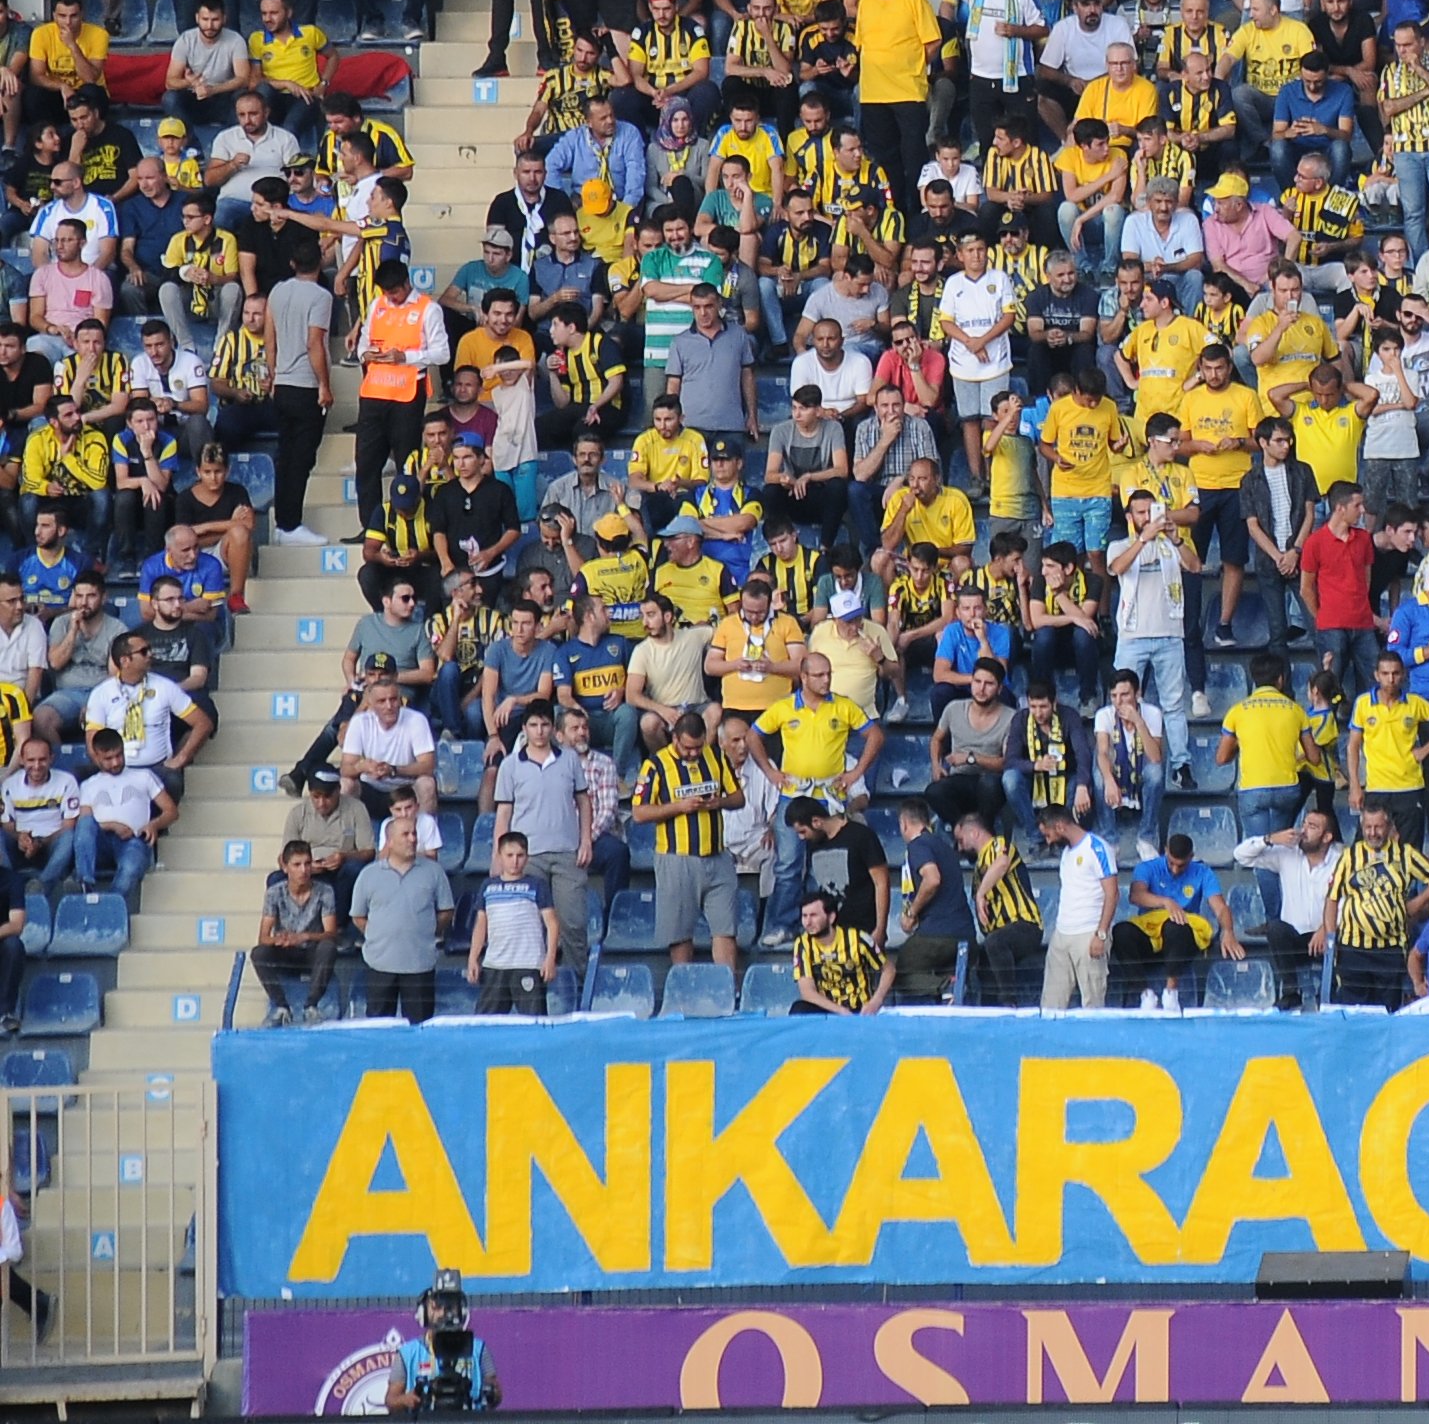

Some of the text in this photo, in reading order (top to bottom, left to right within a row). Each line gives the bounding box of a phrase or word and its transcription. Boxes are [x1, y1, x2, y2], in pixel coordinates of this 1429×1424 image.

[475, 81, 493, 101] T
[324, 551, 345, 571] K
[300, 621, 317, 642] J
[276, 696, 296, 716] H
[254, 770, 274, 790] G
[675, 781, 718, 797] TURKCELL
[228, 844, 245, 864] F
[201, 921, 219, 942] E
[177, 998, 197, 1019] D
[124, 1159, 142, 1180] B
[93, 1235, 114, 1258] A
